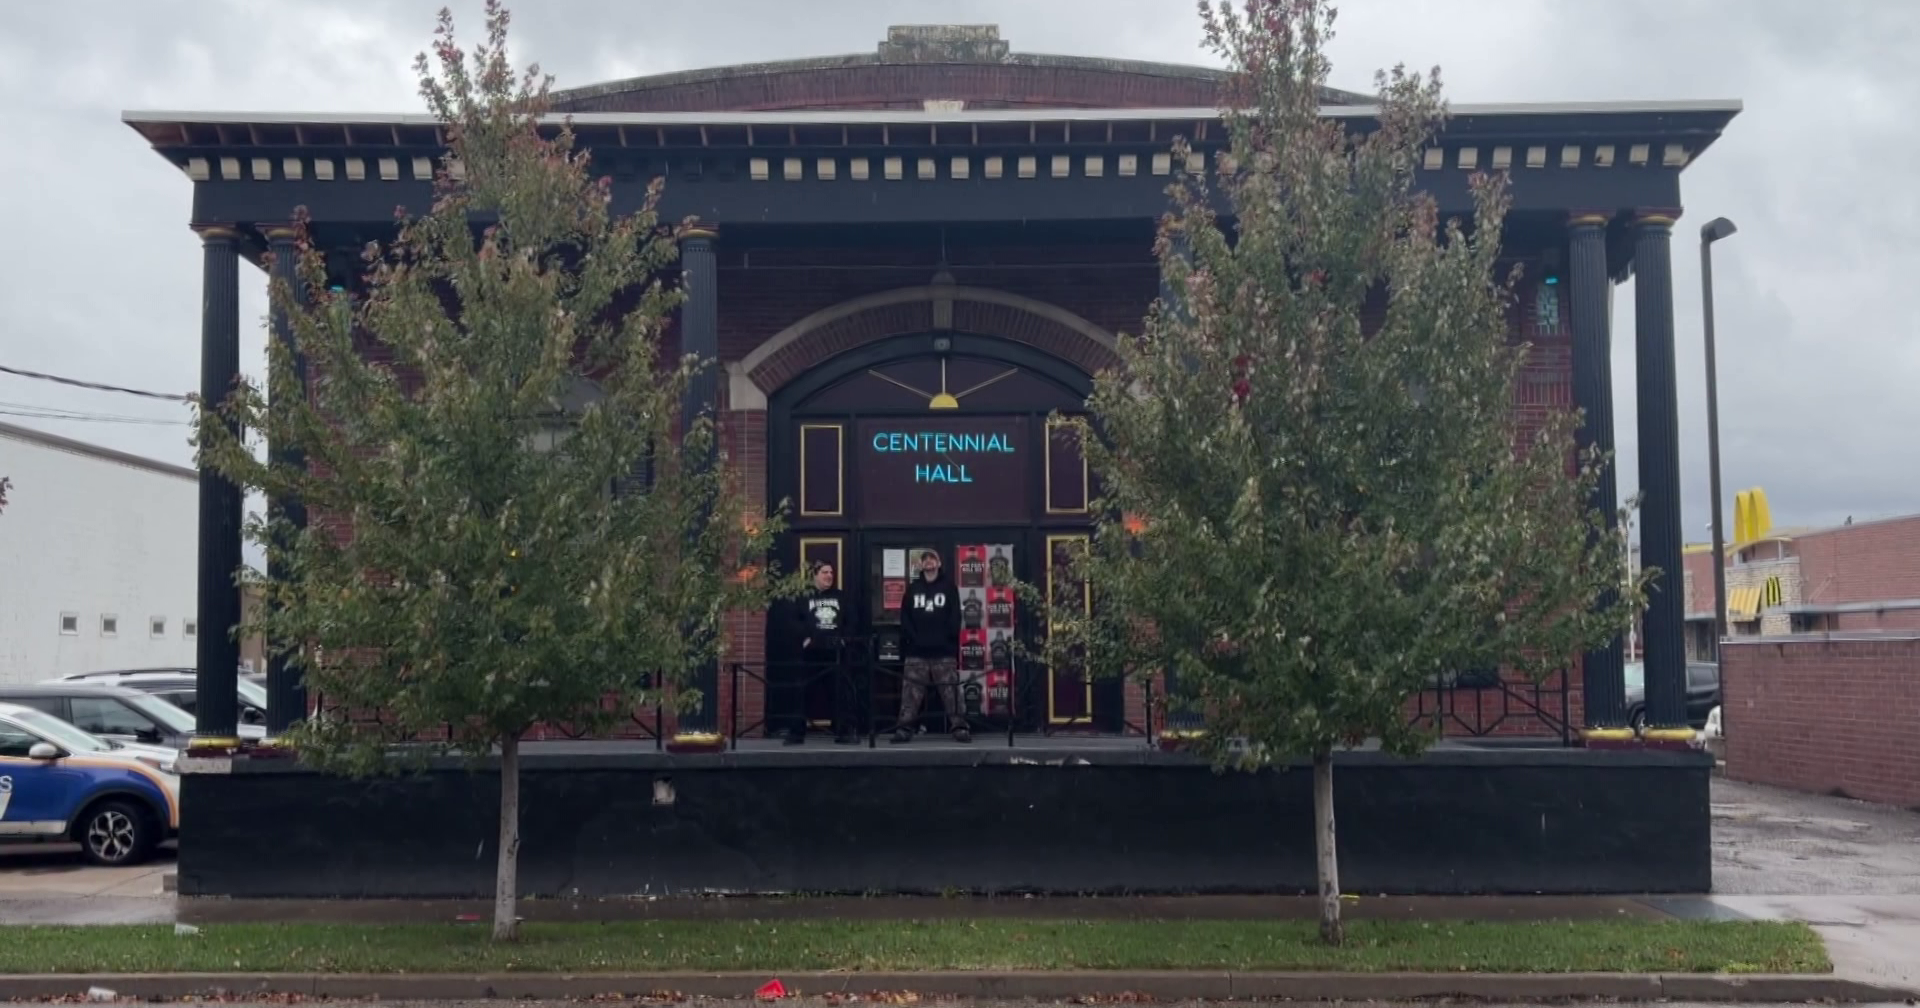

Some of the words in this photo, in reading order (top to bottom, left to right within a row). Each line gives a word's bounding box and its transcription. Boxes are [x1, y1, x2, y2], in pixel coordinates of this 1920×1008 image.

[873, 432, 1015, 452] CENTENNIAL
[915, 464, 973, 483] HALL
[914, 593, 946, 612] H2O
